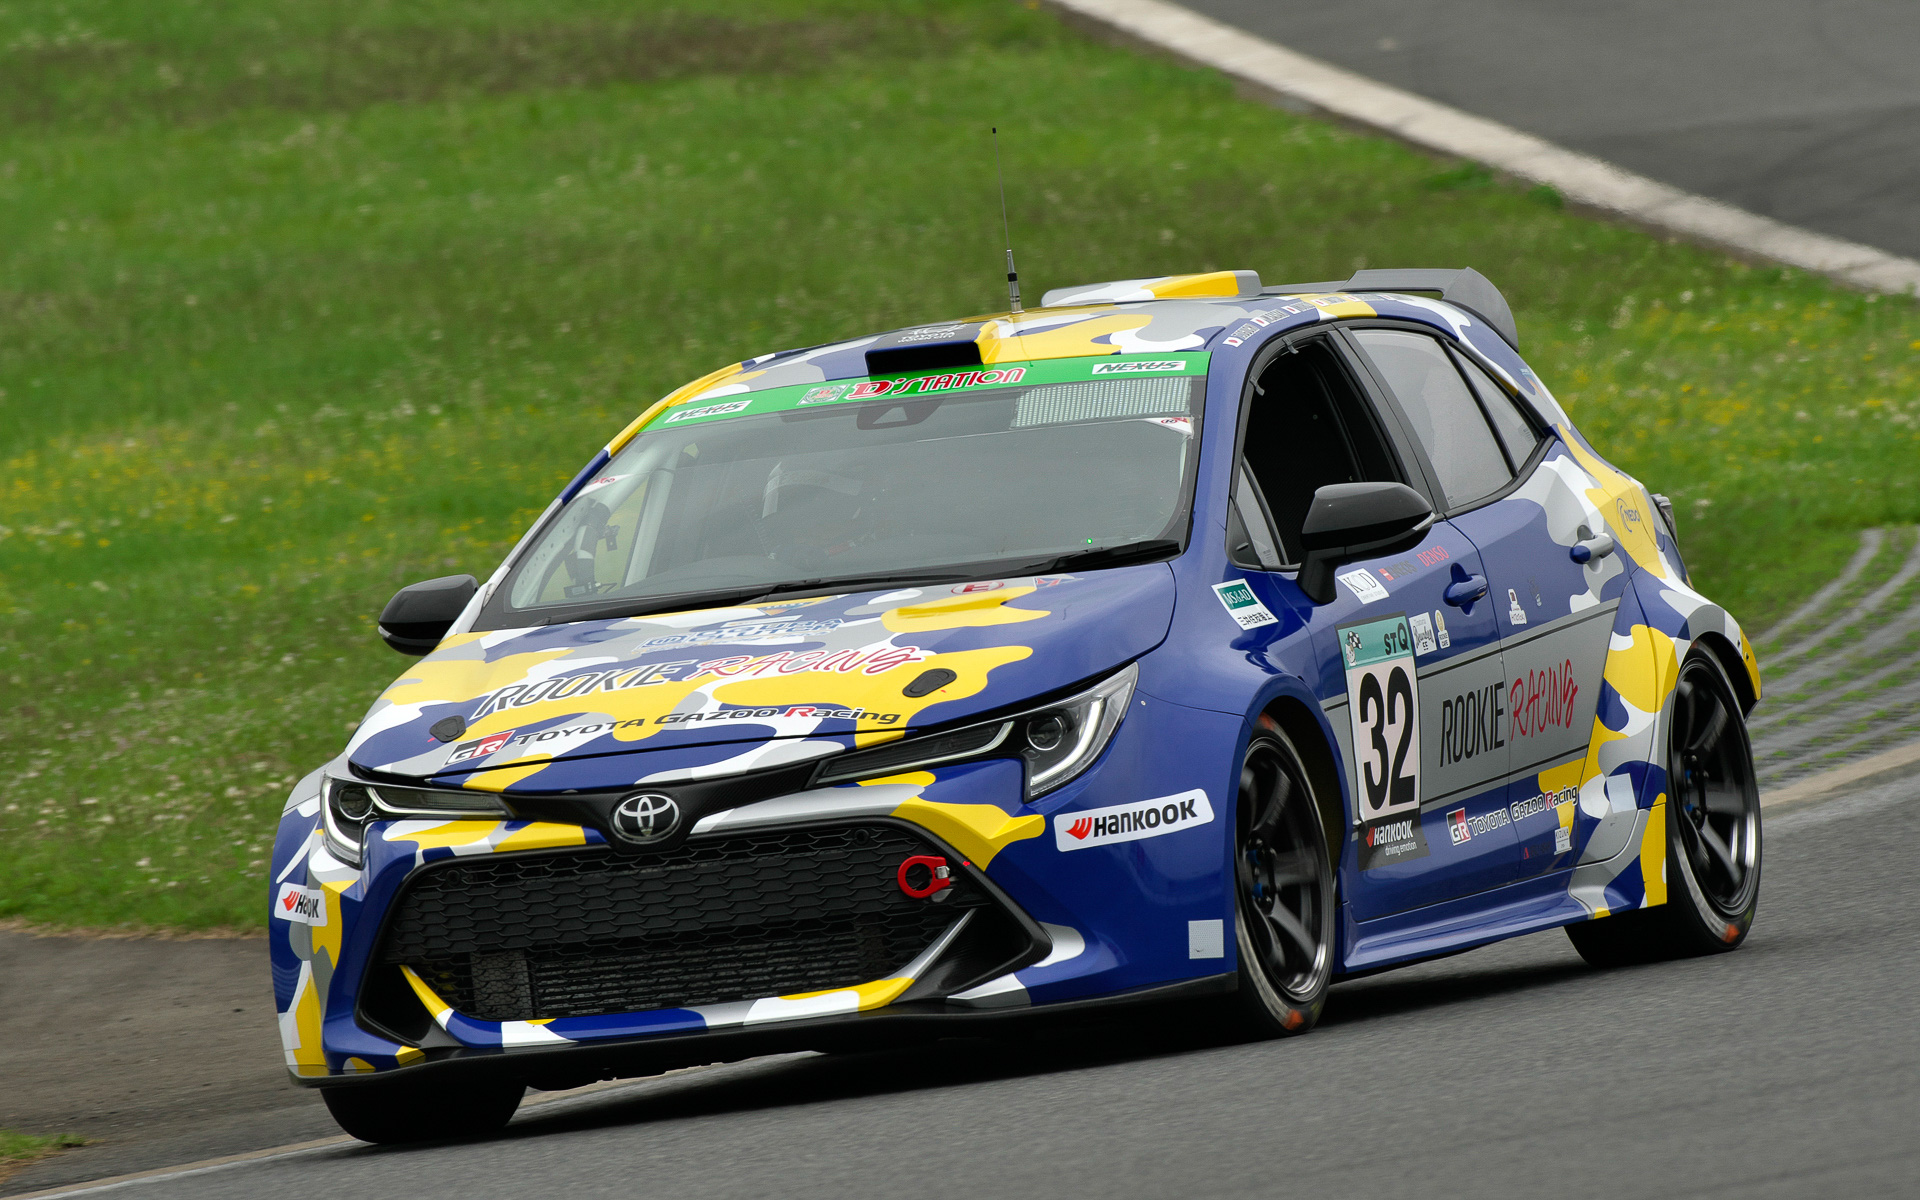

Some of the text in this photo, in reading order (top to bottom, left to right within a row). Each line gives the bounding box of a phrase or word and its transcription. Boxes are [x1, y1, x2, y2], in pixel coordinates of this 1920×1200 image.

[1097, 361, 1181, 373] NEXUS
[845, 367, 1027, 400] D'STATION
[669, 401, 747, 422] NEXUS
[1385, 560, 1418, 579] ENEOS
[1416, 545, 1449, 567] DENSO
[1222, 588, 1251, 608] MS&AD
[472, 646, 922, 718] ROOKIE RACING
[1439, 658, 1578, 768] ROOKIE RACING
[447, 706, 902, 765] GR TOYOTA GAZOO Racing
[1359, 665, 1417, 811] 32
[1450, 784, 1578, 843] GR TOYOTA GAZOO Racing
[1385, 840, 1418, 856] driving emotion
